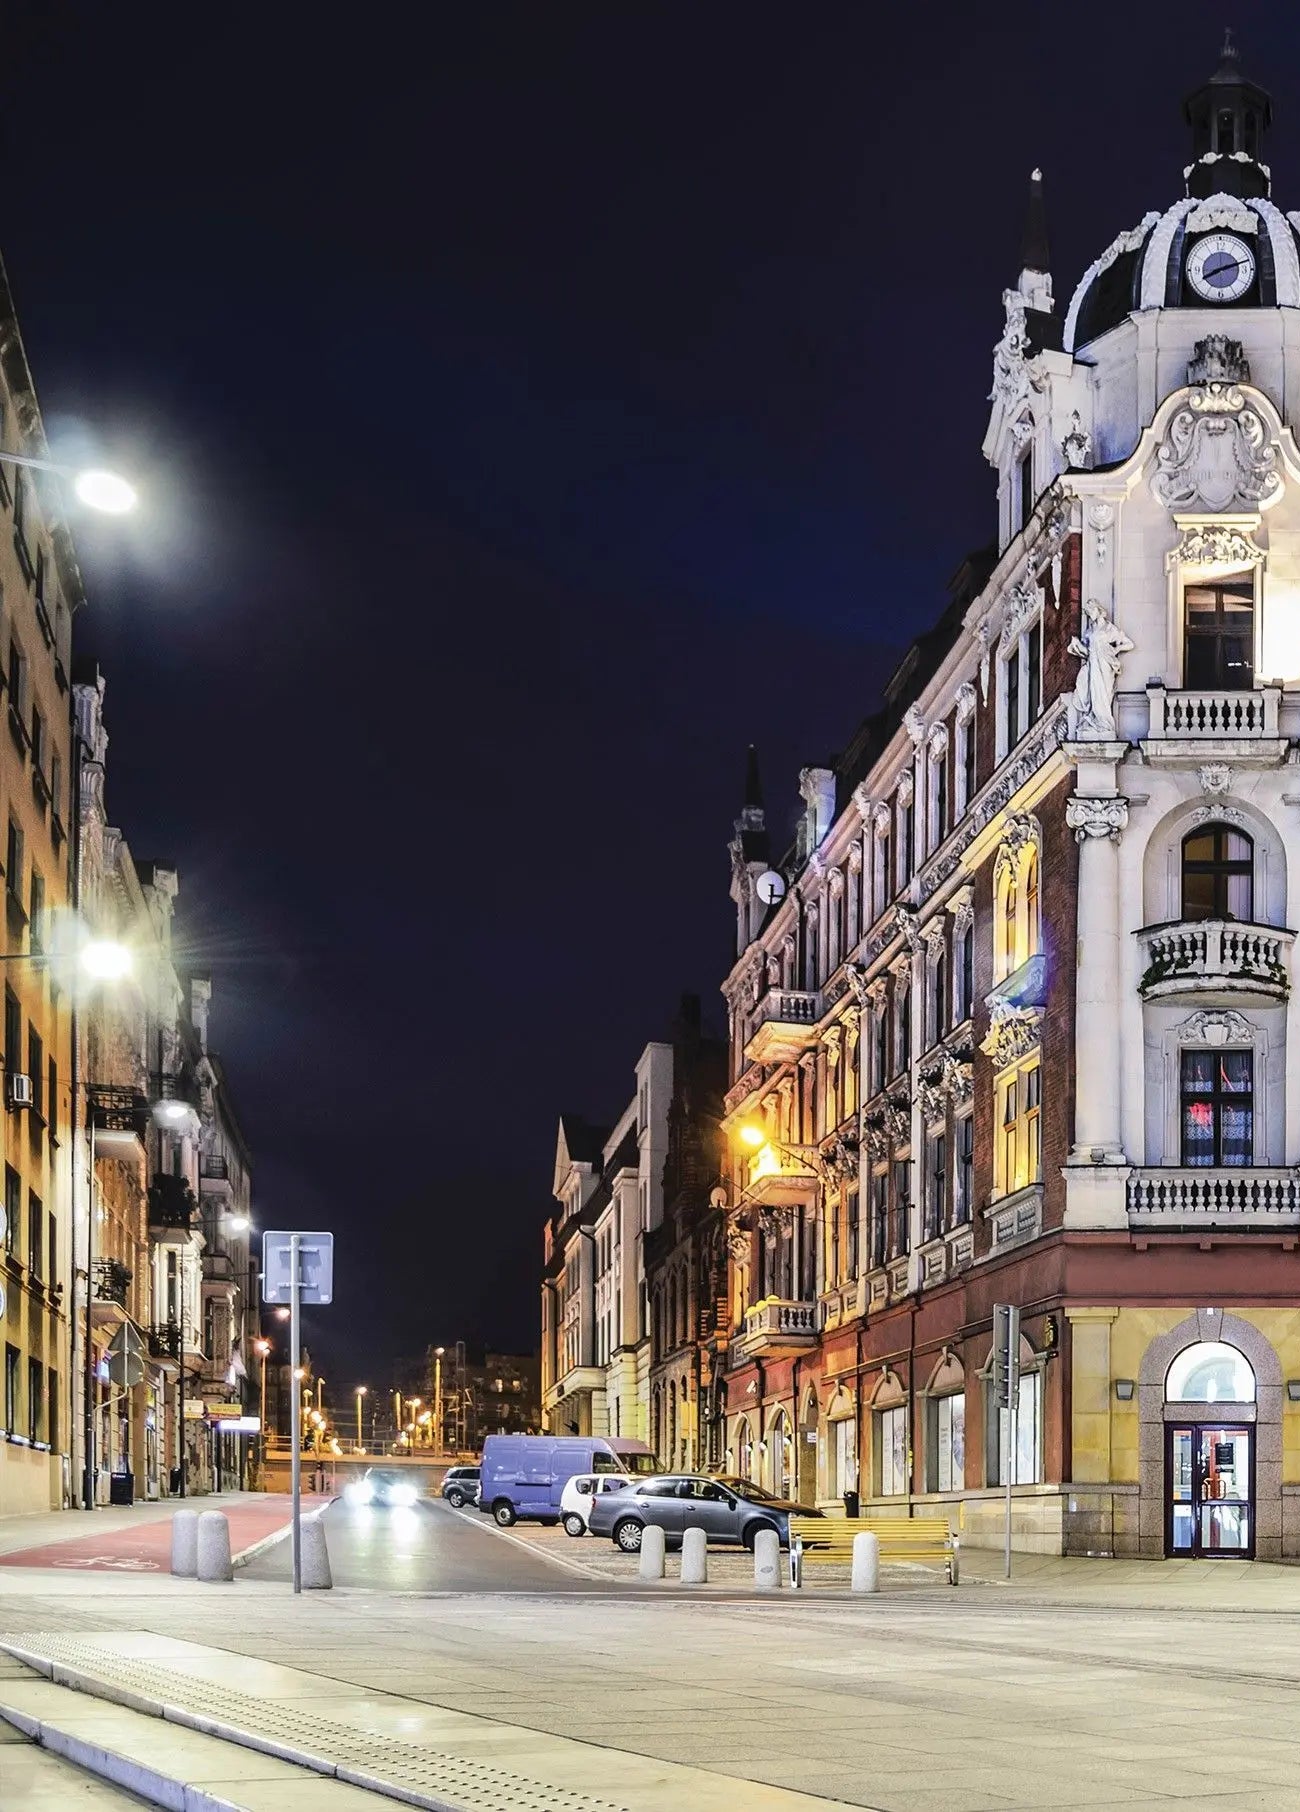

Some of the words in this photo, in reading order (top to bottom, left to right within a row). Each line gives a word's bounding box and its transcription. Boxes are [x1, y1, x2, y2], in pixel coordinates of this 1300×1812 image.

[1216, 241, 1226, 251] 12
[1194, 266, 1201, 275] 9
[1241, 265, 1247, 274] 3
[1218, 290, 1224, 298] 6
